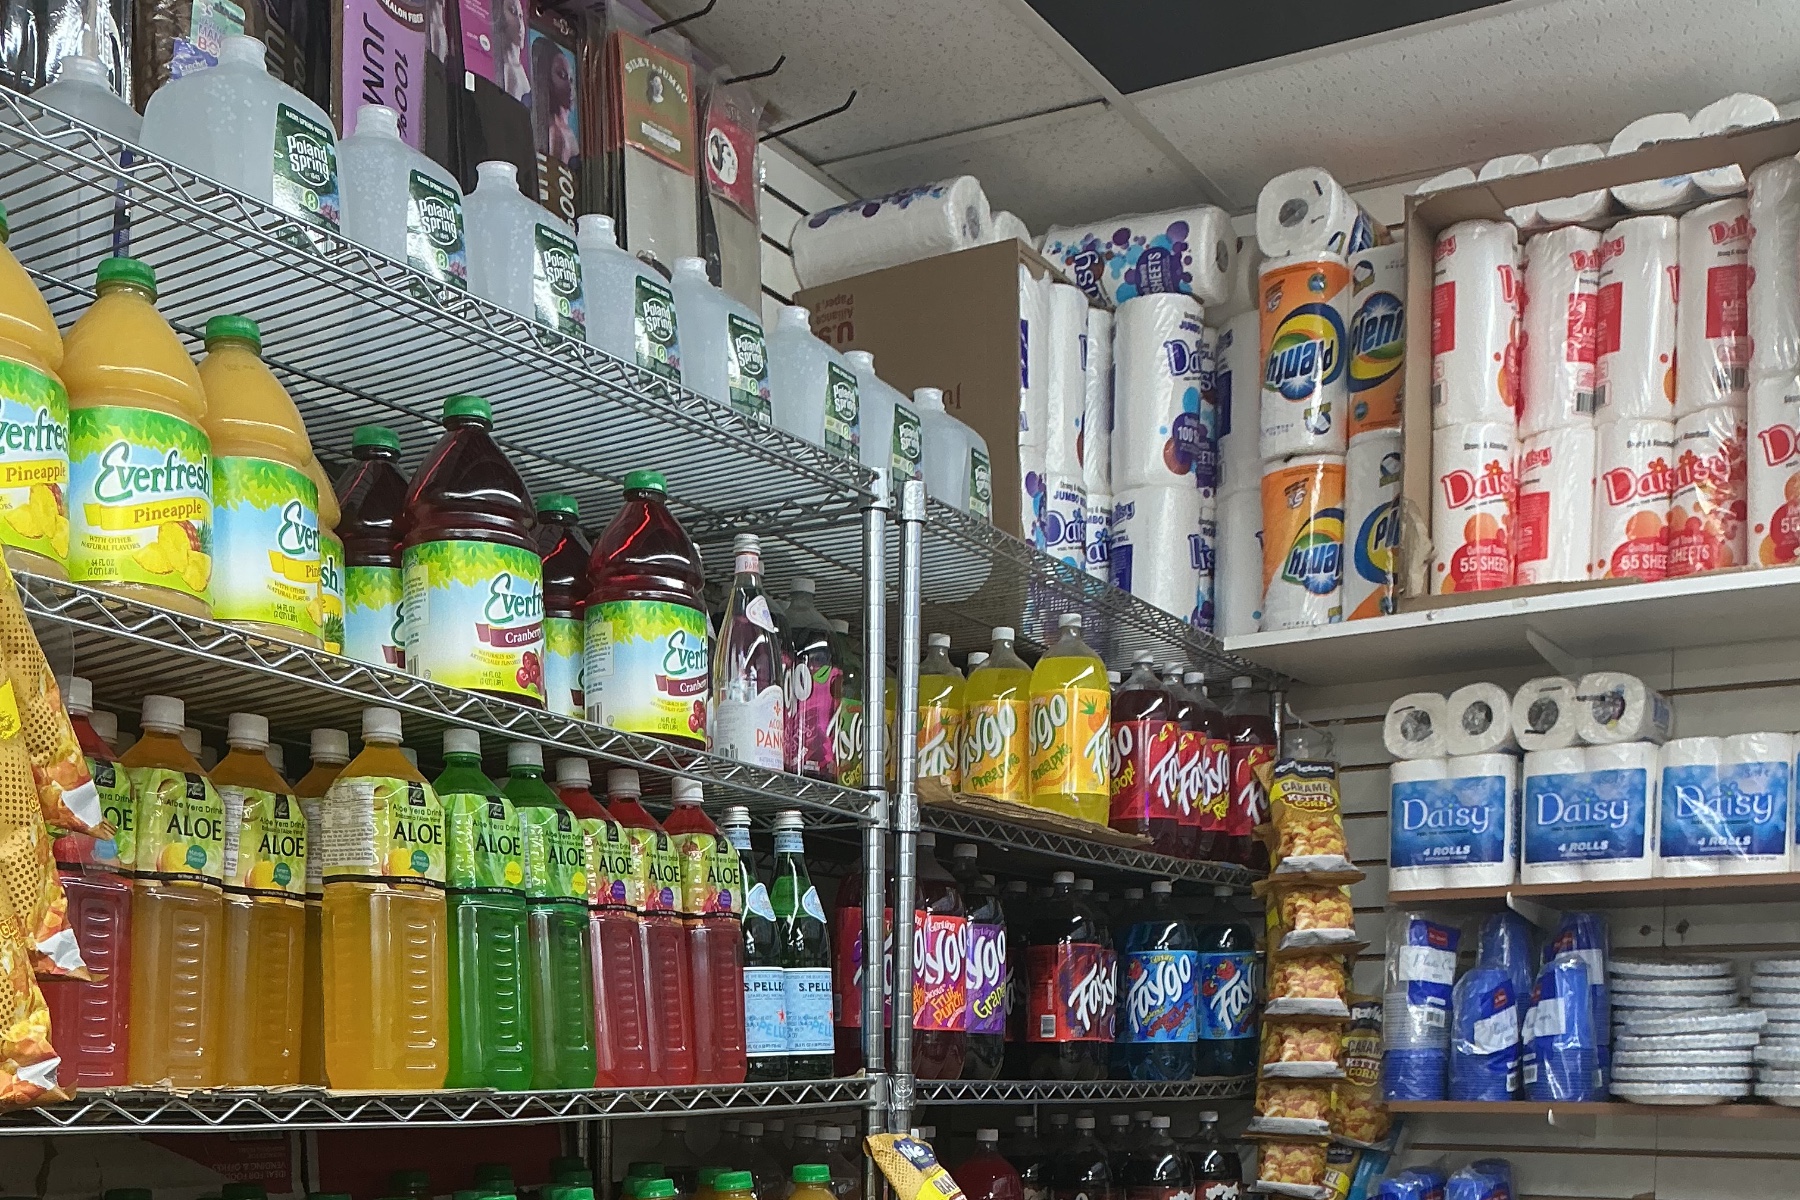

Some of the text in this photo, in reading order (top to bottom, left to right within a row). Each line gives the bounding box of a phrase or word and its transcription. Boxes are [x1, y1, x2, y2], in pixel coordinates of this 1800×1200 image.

[408, 12, 424, 24] FIBER
[624, 57, 650, 74] SILKY
[657, 66, 688, 103] JUMBO
[286, 135, 328, 165] Poland
[289, 153, 330, 181] Spring
[419, 200, 455, 222] Poland
[421, 216, 457, 240] Spring
[543, 251, 576, 273] Poland
[545, 266, 577, 286] Spring
[643, 300, 671, 321] Poland
[645, 317, 673, 336] Spring
[735, 338, 762, 356] Poland
[737, 352, 764, 370] Spring
[5, 463, 66, 485] Pineapple
[94, 441, 211, 503] Everfresh
[133, 501, 203, 524] Pineapple
[81, 541, 141, 553] NATURAL FLAVORS
[107, 535, 133, 545] OTHER
[1460, 557, 1478, 573] 55
[1620, 556, 1640, 570] 55
[113, 793, 134, 804] Drink
[166, 798, 224, 815] Aloe Vera Drink
[1294, 800, 1328, 808] CORN
[1674, 783, 1775, 825] Daisy
[392, 803, 443, 817] Aloe Vera Drink
[1402, 797, 1495, 833] Daisy
[1536, 792, 1634, 830] Daisy
[166, 813, 223, 842] ALOE
[259, 816, 306, 830] Aloe Vera Drink
[392, 820, 443, 846] ALOE
[472, 819, 488, 829] Aloe
[489, 821, 505, 831] Vera
[258, 833, 305, 858] ALOE
[475, 832, 522, 857] ALOE
[1423, 843, 1471, 857] 4 ROLLS
[1557, 840, 1609, 853] 4 ROLLS
[1697, 834, 1752, 848] 4 ROLLS
[547, 845, 586, 867] ALOE
[598, 854, 634, 875] ALOE
[648, 861, 681, 883] ALOE
[706, 865, 740, 885] ALOE
[1127, 954, 1191, 1034] Faygo
